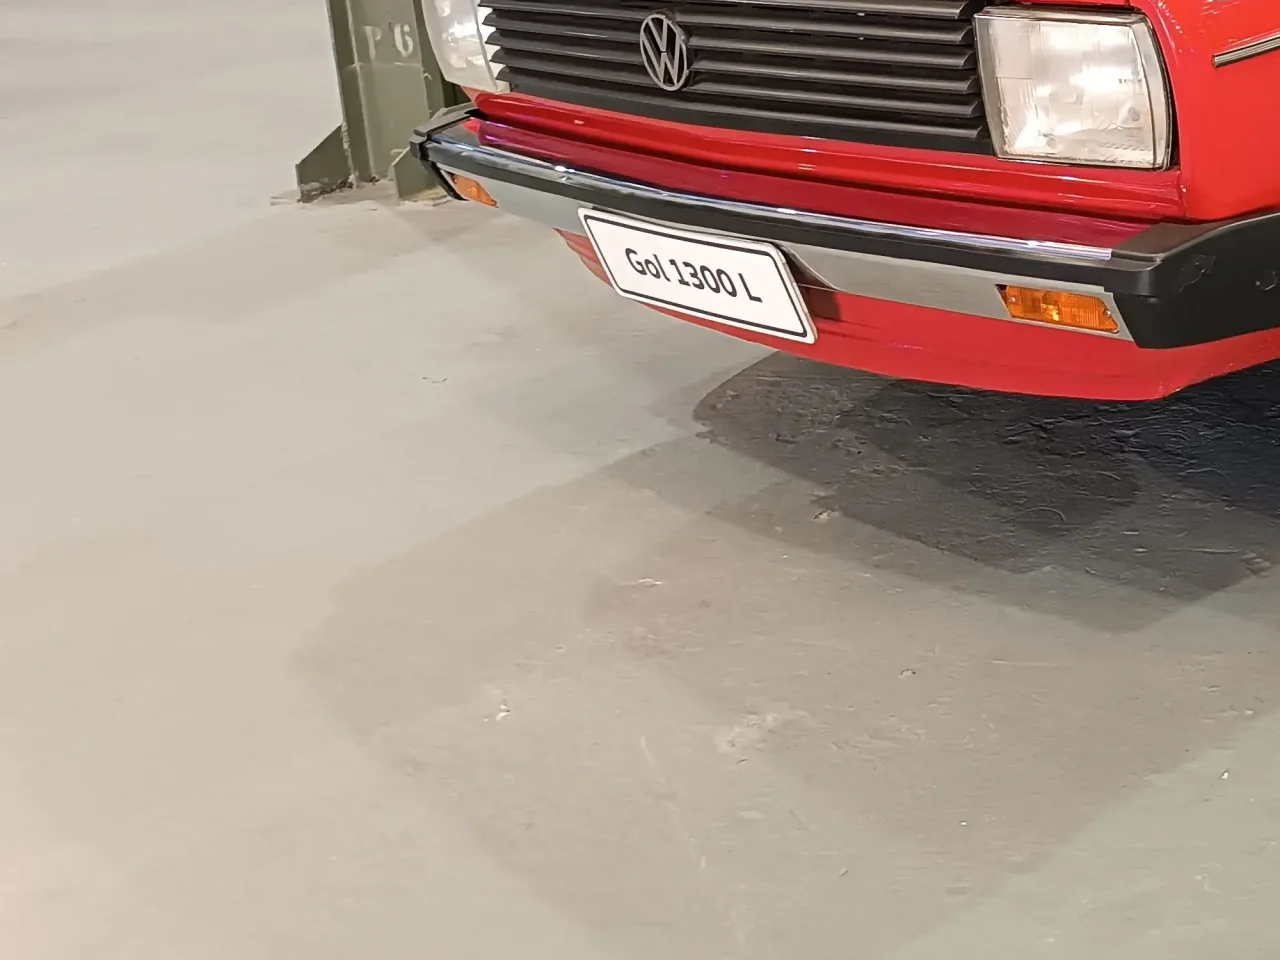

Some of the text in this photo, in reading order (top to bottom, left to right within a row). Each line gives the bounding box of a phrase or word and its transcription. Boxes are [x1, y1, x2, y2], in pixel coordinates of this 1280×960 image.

[640, 14, 687, 92] VW
[625, 247, 763, 303] Gol 1300 L
